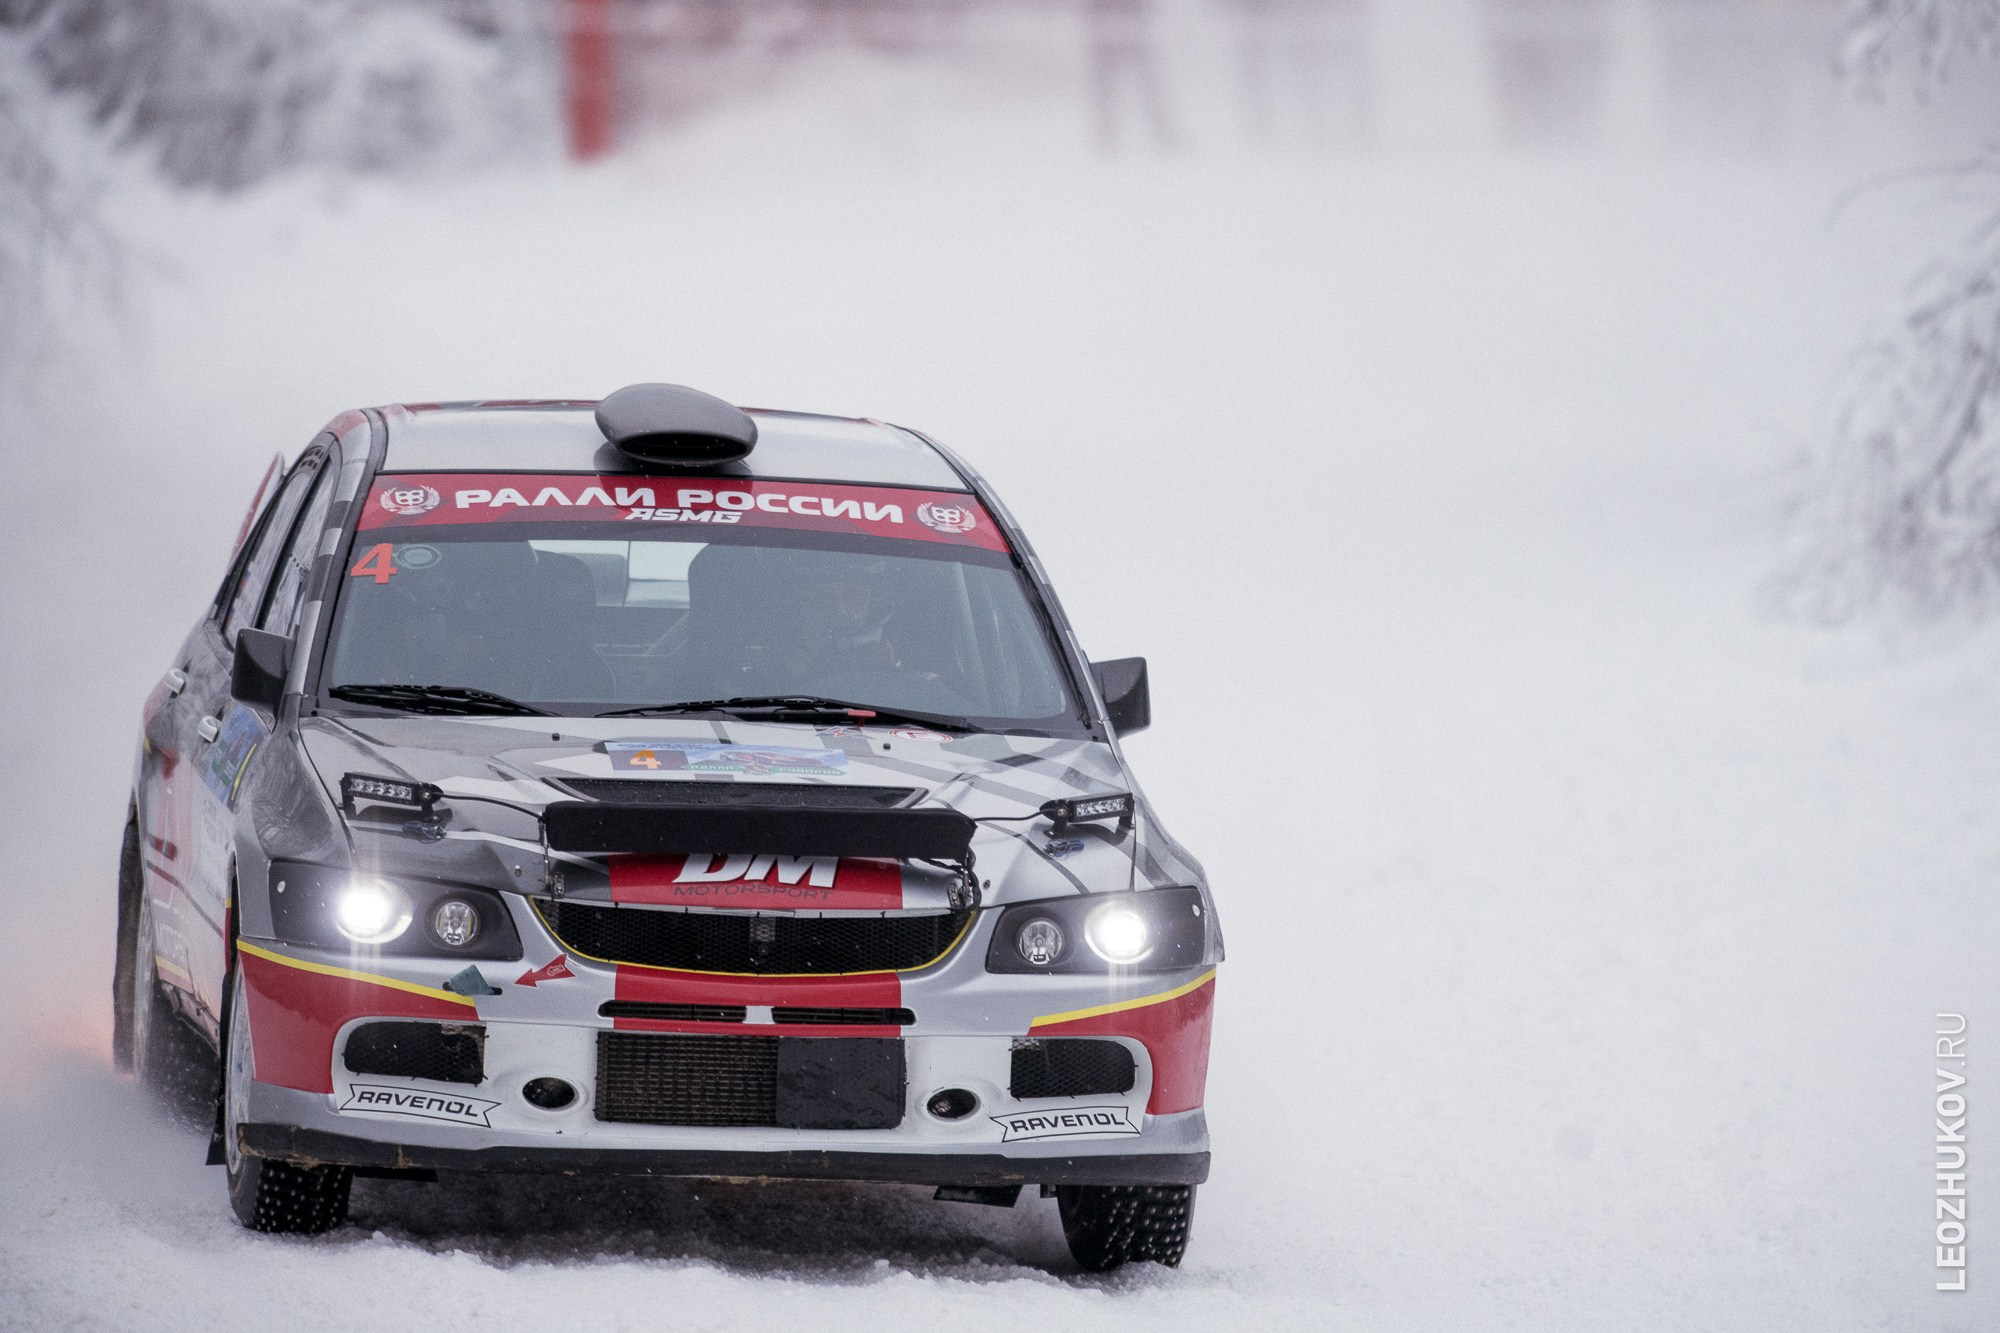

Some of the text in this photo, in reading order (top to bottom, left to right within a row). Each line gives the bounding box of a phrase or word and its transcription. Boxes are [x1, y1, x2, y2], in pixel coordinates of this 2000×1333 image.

[455, 487, 904, 523] РАЛЛИ РОССИИ
[350, 543, 398, 584] 4
[630, 749, 662, 770] 4
[671, 853, 839, 888] DM
[673, 884, 834, 900] MOTORSPORT
[357, 1091, 478, 1117] RAVENOL
[1009, 1113, 1125, 1133] RAVENOL
